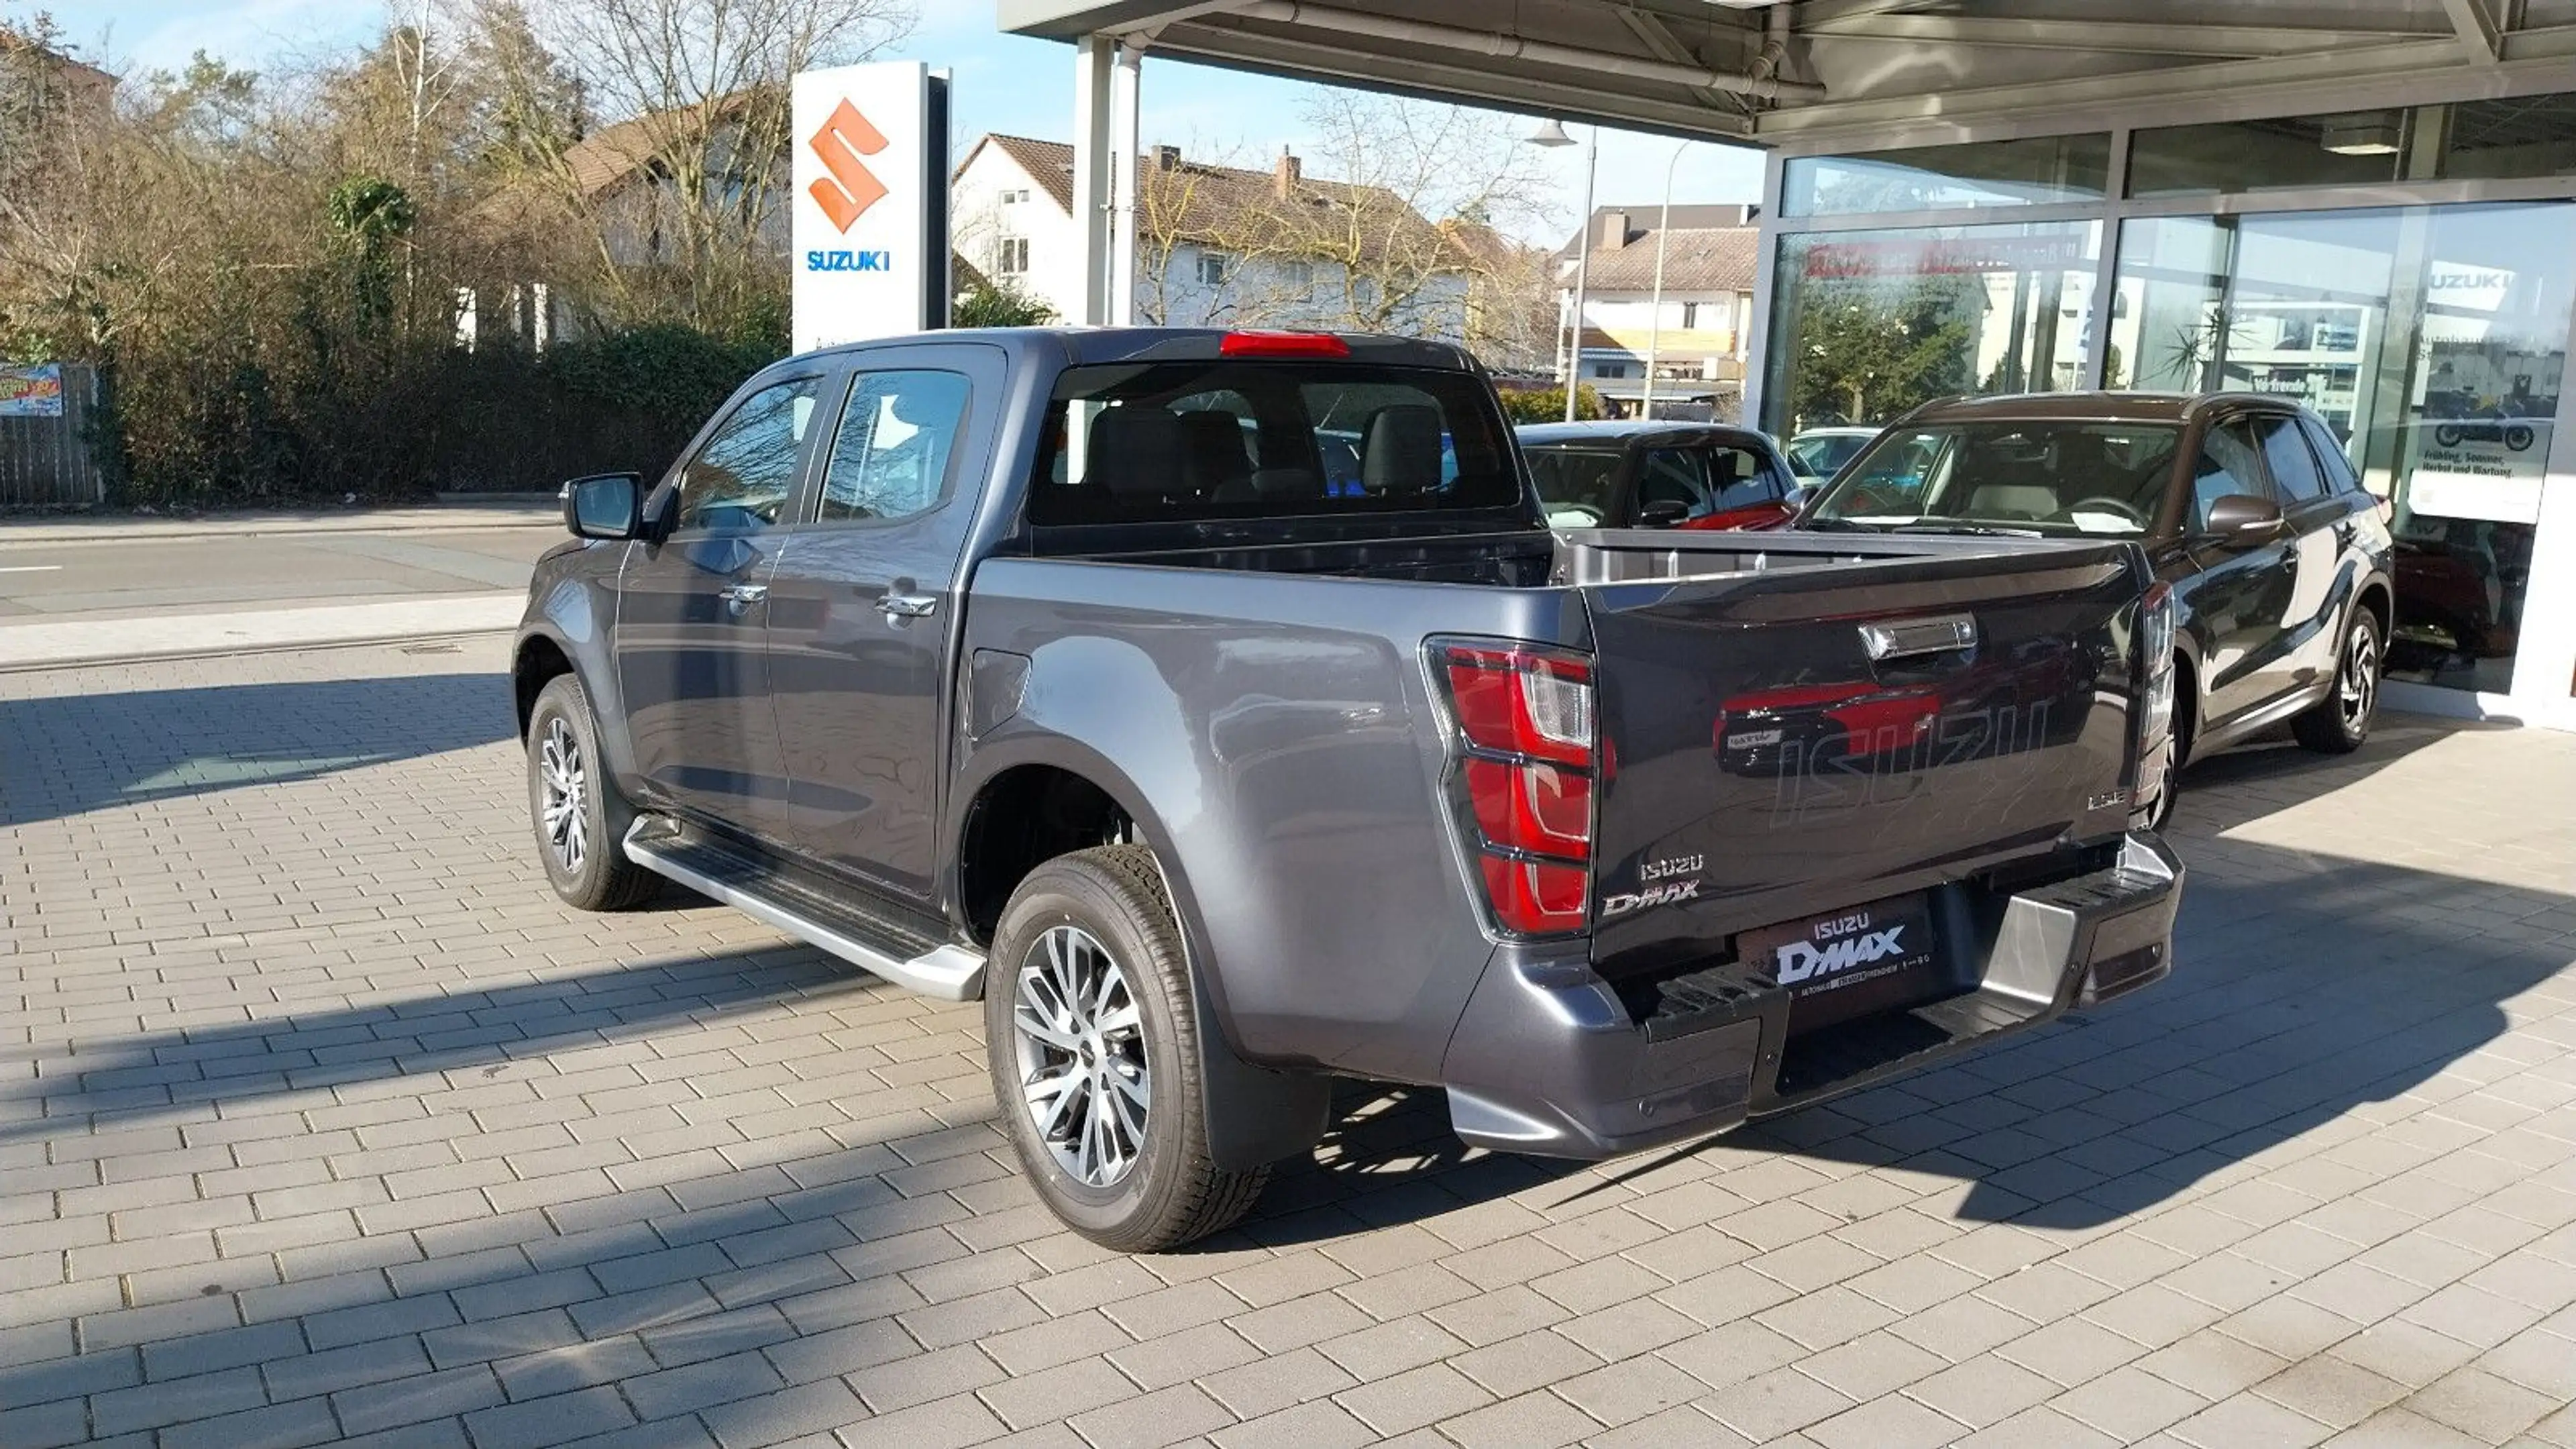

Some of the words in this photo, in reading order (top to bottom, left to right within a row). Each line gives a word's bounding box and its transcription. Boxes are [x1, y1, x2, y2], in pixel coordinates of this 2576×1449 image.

[808, 251, 890, 271] SUZUKI
[2427, 273, 2510, 289] UZUKI
[1640, 854, 1703, 880] ISUZU
[1815, 912, 1870, 939] ISUZU
